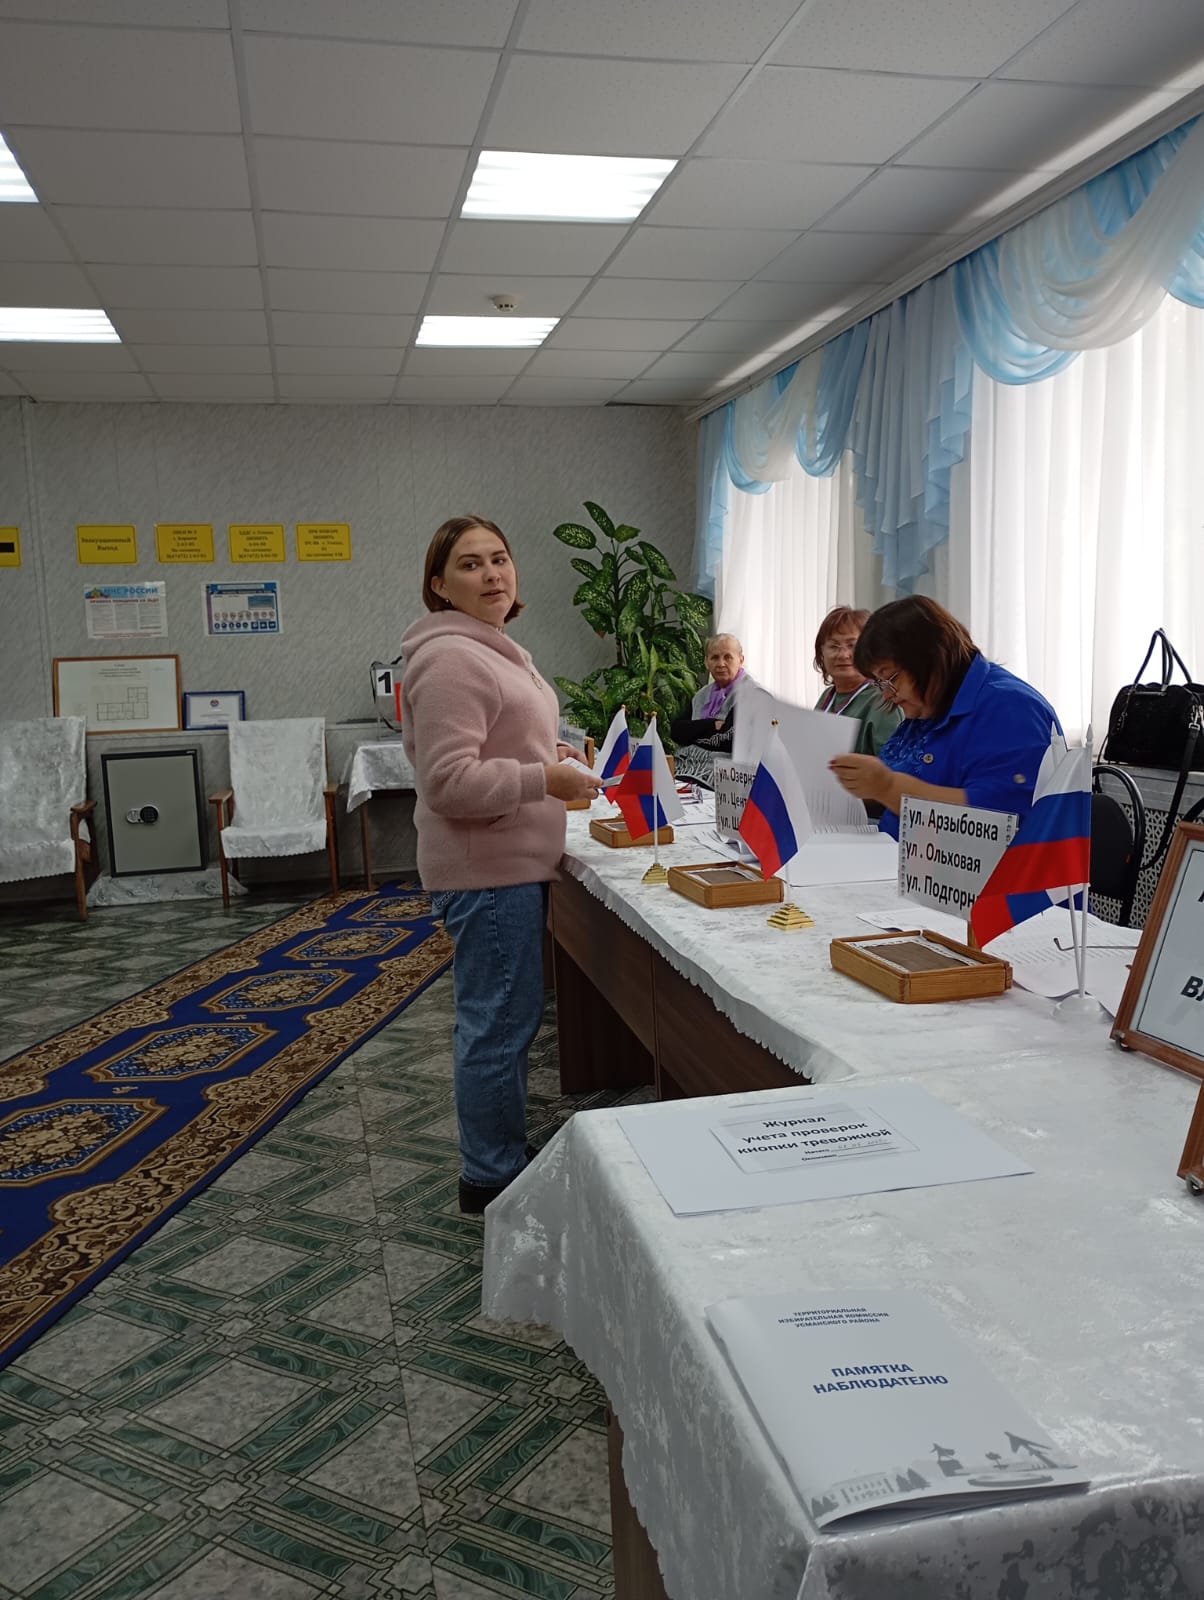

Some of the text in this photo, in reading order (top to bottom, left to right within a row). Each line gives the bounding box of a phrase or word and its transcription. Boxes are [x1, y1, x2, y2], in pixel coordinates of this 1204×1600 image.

[378, 671, 391, 694] 1
[909, 808, 999, 841] ул. Арзыбовка
[926, 842, 981, 873] Ольховая
[906, 873, 979, 911] ул. Подгорн
[742, 1122, 869, 1144] учета проверок
[763, 1116, 827, 1128] Журнал
[737, 1142, 799, 1154] кнопки
[800, 1129, 893, 1147] тревожной
[778, 1314, 844, 1324] ИЗБИРАТЕЛЬНАЯ
[793, 1308, 867, 1317] ТЕРРИТОРИАЛЬНАЯ
[831, 1363, 914, 1377] ПАМЯТКА
[813, 1375, 949, 1394] НАБЛЮДАТЕЛЮ
